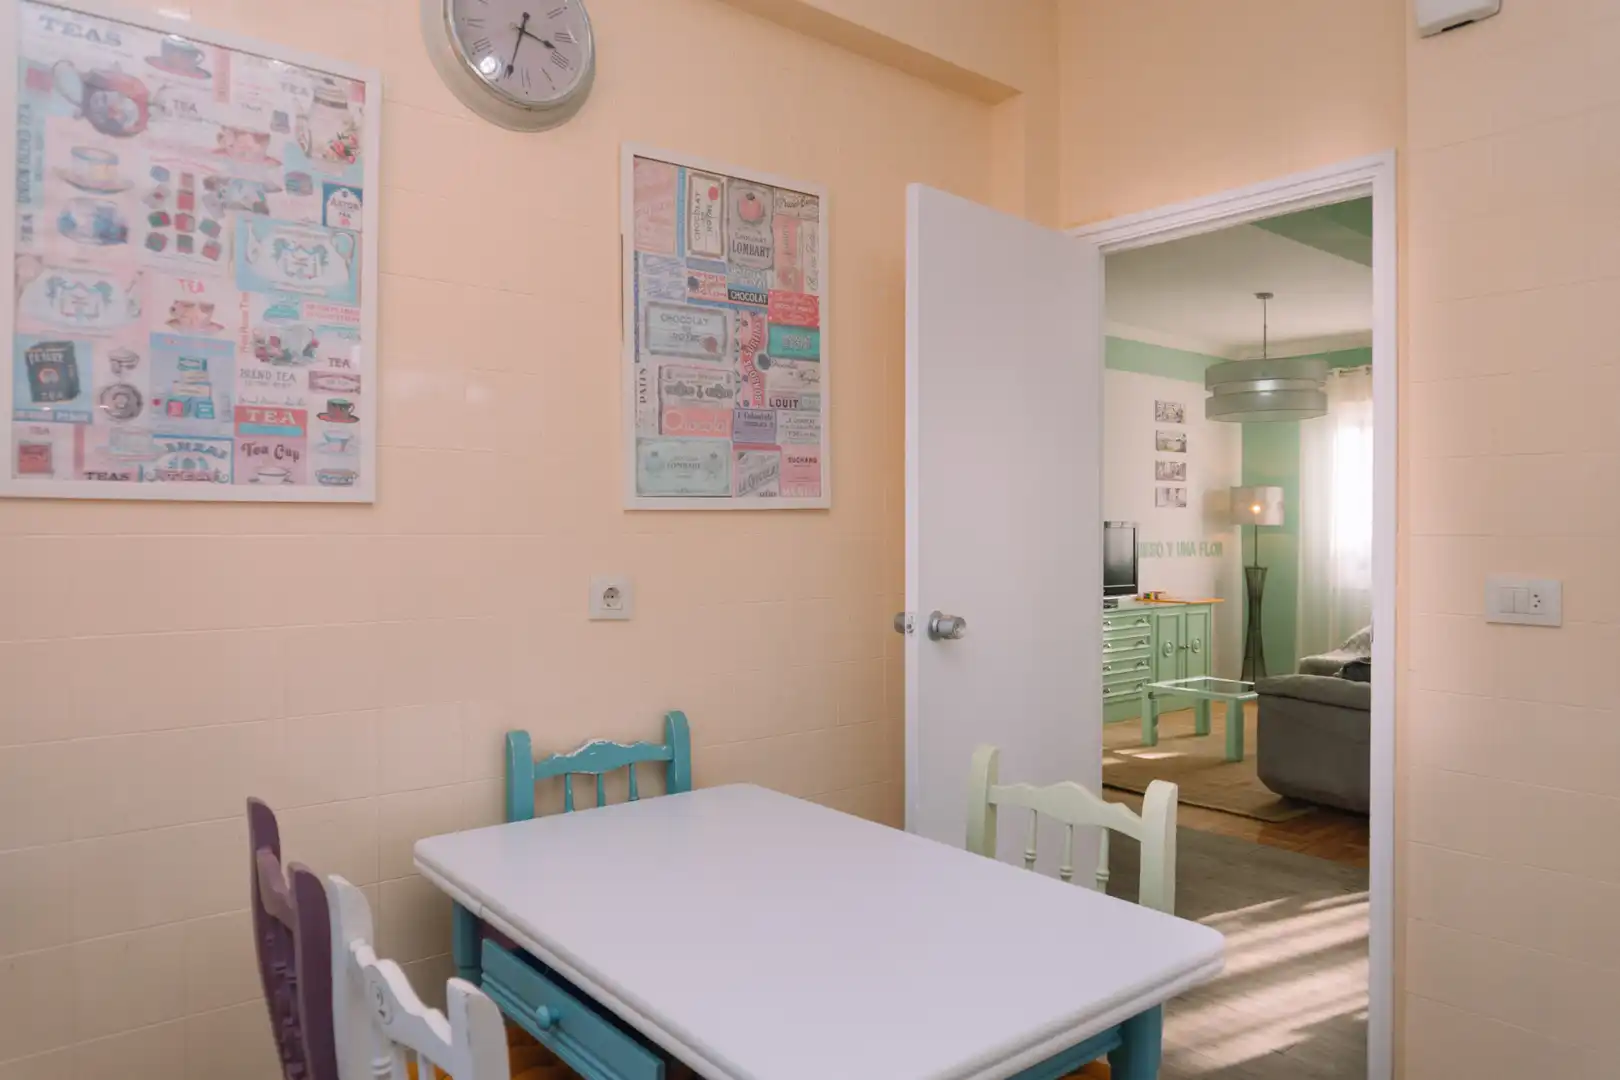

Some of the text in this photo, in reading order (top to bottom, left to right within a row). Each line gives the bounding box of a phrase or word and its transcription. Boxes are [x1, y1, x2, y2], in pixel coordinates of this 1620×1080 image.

[39, 14, 122, 46] TEAS
[173, 99, 198, 114] TEA
[732, 239, 771, 259] LOMBART
[178, 278, 205, 293] TEA
[730, 290, 768, 304] CHOCOLAT
[328, 357, 350, 369] TEA
[276, 371, 297, 384] TEA
[769, 398, 799, 409] LOUIT
[246, 408, 297, 425] TEA
[241, 441, 270, 457] Tea
[273, 444, 300, 463] Cup
[84, 470, 130, 481] TEAS
[1166, 541, 1174, 557] Y
[1176, 541, 1196, 557] UNA
[1199, 541, 1223, 557] FLOR
